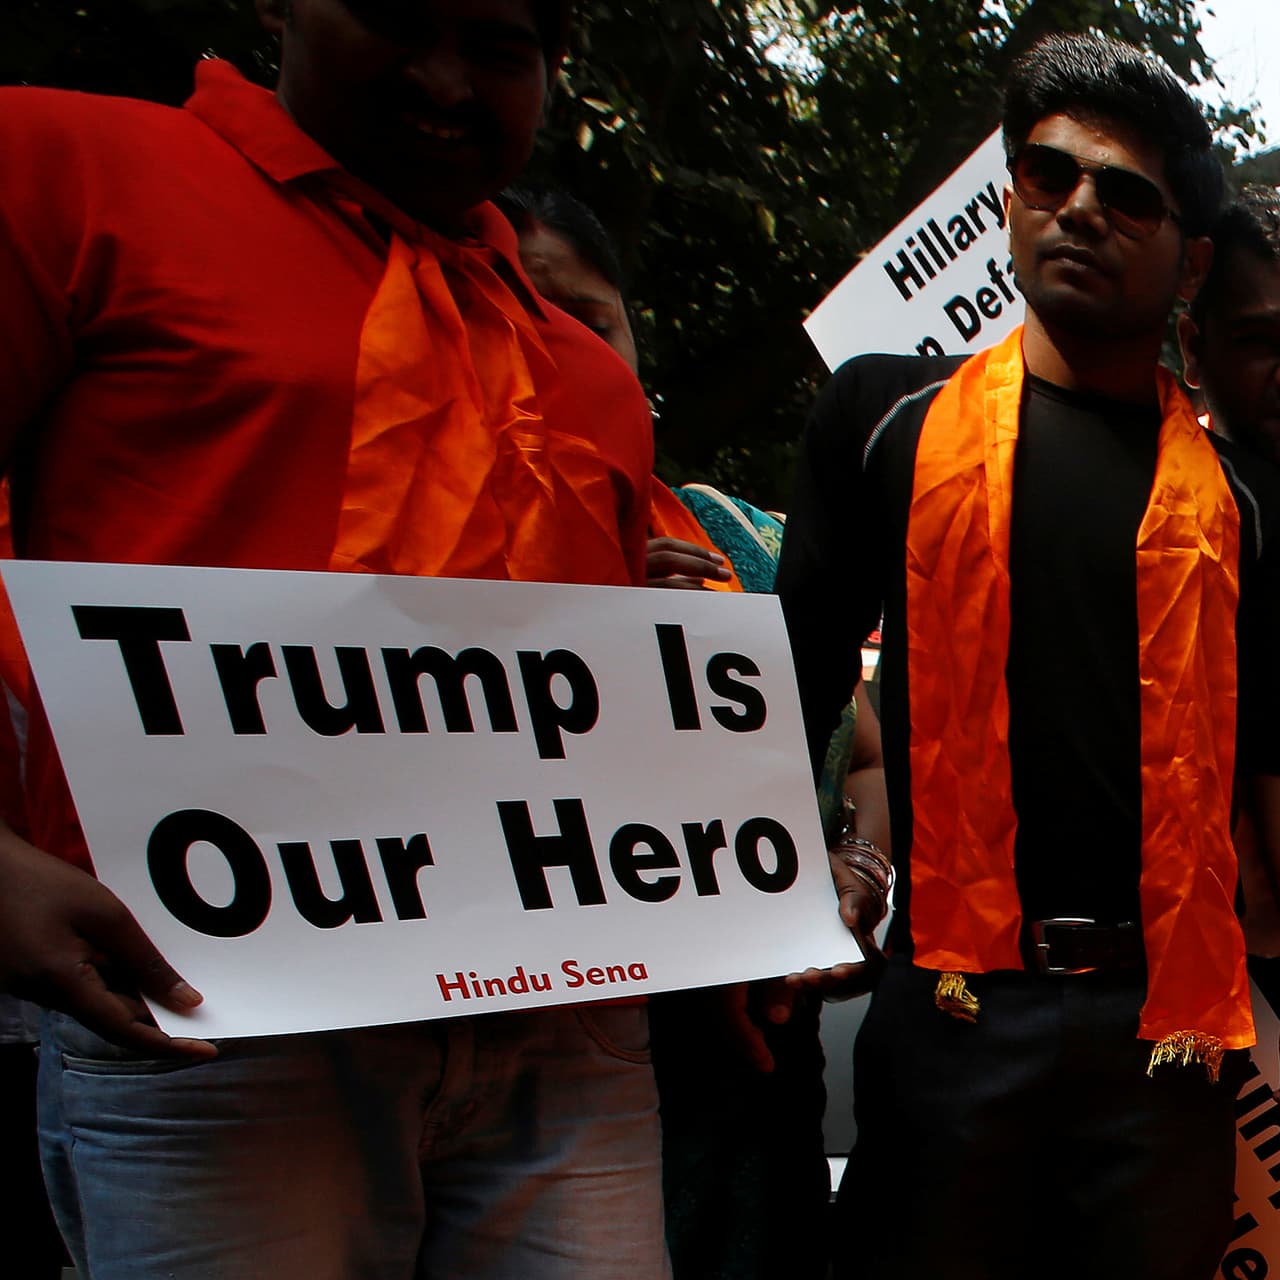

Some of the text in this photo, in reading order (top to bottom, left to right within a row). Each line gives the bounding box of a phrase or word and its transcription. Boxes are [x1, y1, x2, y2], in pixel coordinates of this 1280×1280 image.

[882, 181, 1007, 301] Hillary
[943, 257, 1018, 343] Def
[71, 604, 767, 760] Trump Is
[146, 798, 800, 939] Our Hero
[435, 958, 649, 1002] Hindu Sena
